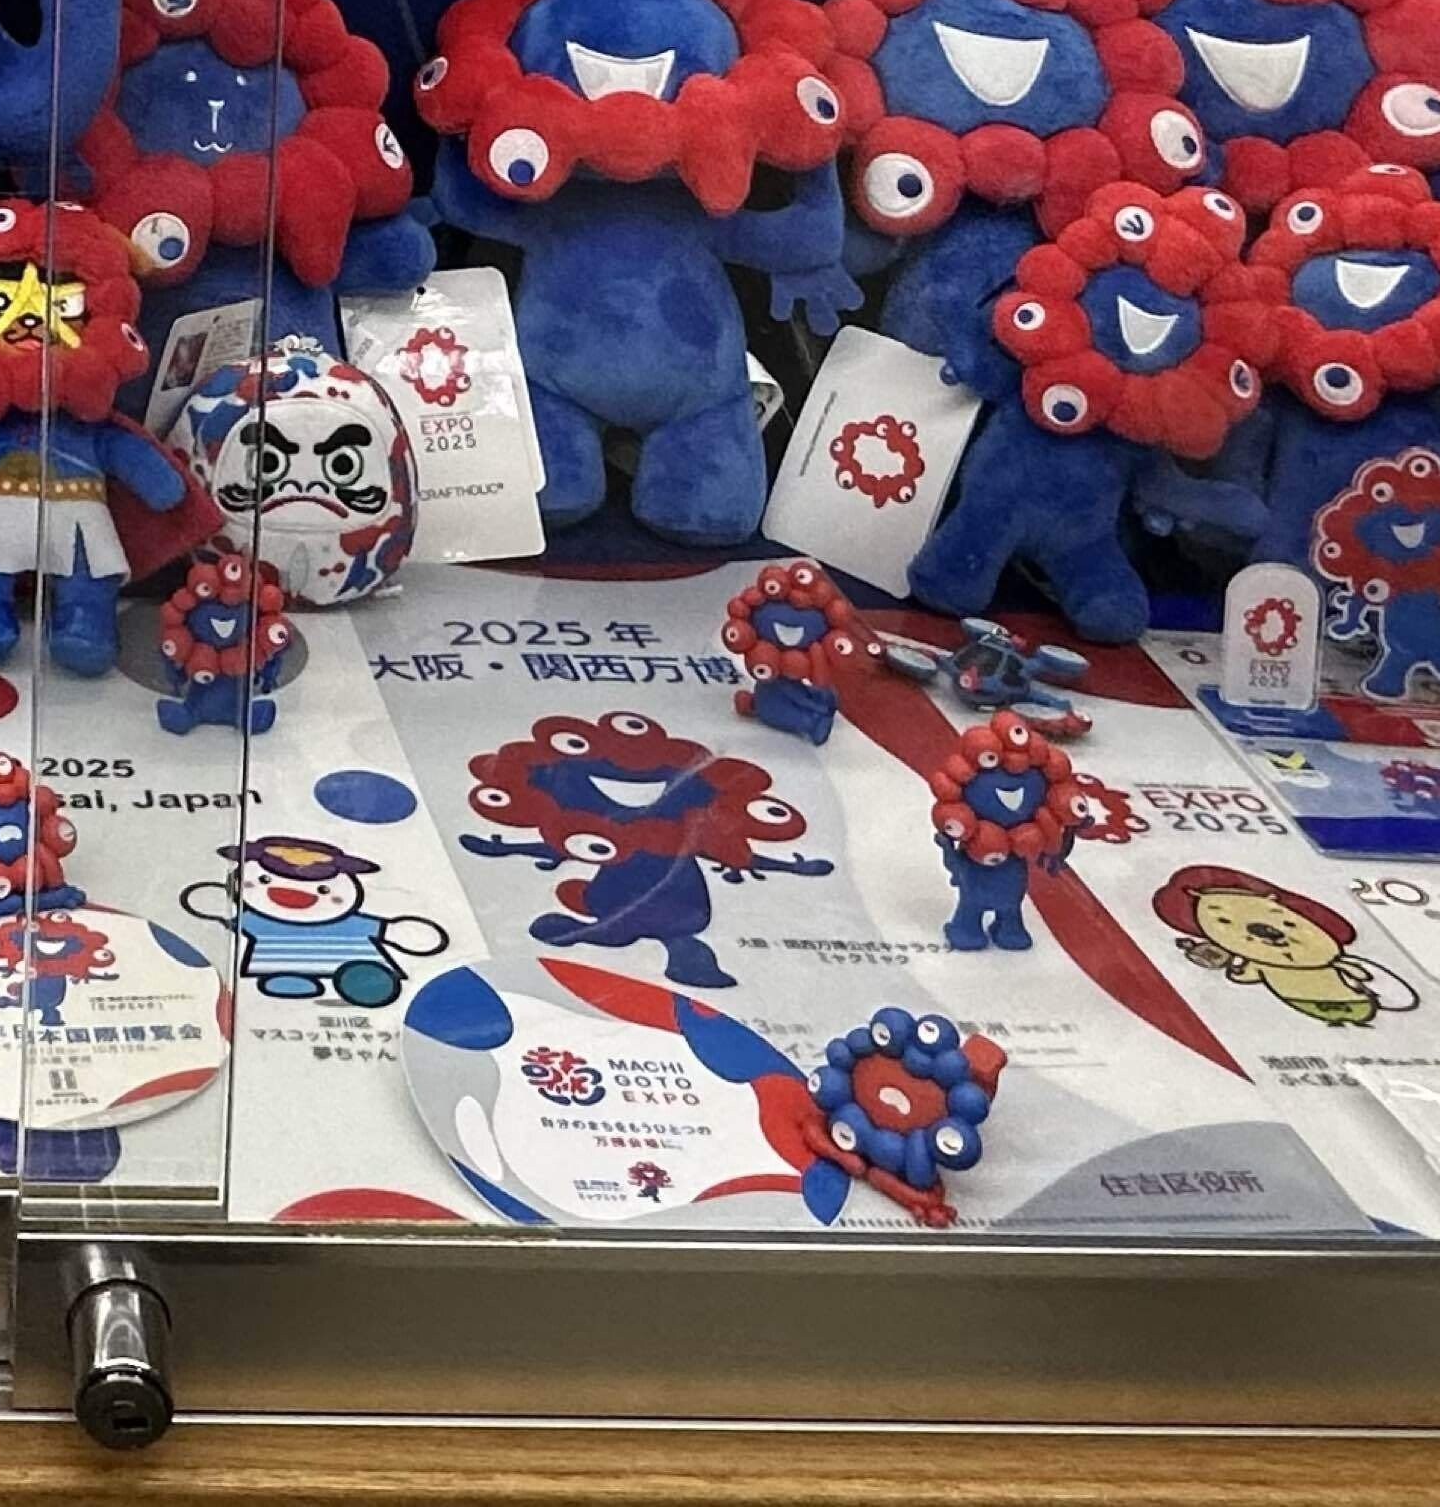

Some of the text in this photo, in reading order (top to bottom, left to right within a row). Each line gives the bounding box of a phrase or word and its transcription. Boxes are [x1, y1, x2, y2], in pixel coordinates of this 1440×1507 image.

[420, 417, 474, 436] EXPO
[424, 435, 477, 453] 2025
[443, 620, 662, 649] 2025 年
[369, 653, 748, 687] 大阪・関西万博
[40, 756, 136, 779] 2025
[130, 788, 263, 814] Japan
[1140, 790, 1269, 813] EXPO
[1161, 810, 1289, 836] 2025
[608, 1058, 685, 1075] MACHI
[614, 1074, 694, 1090] GOTO
[621, 1091, 702, 1107] EXPO
[1097, 1169, 1265, 1196] 住吉区役所
